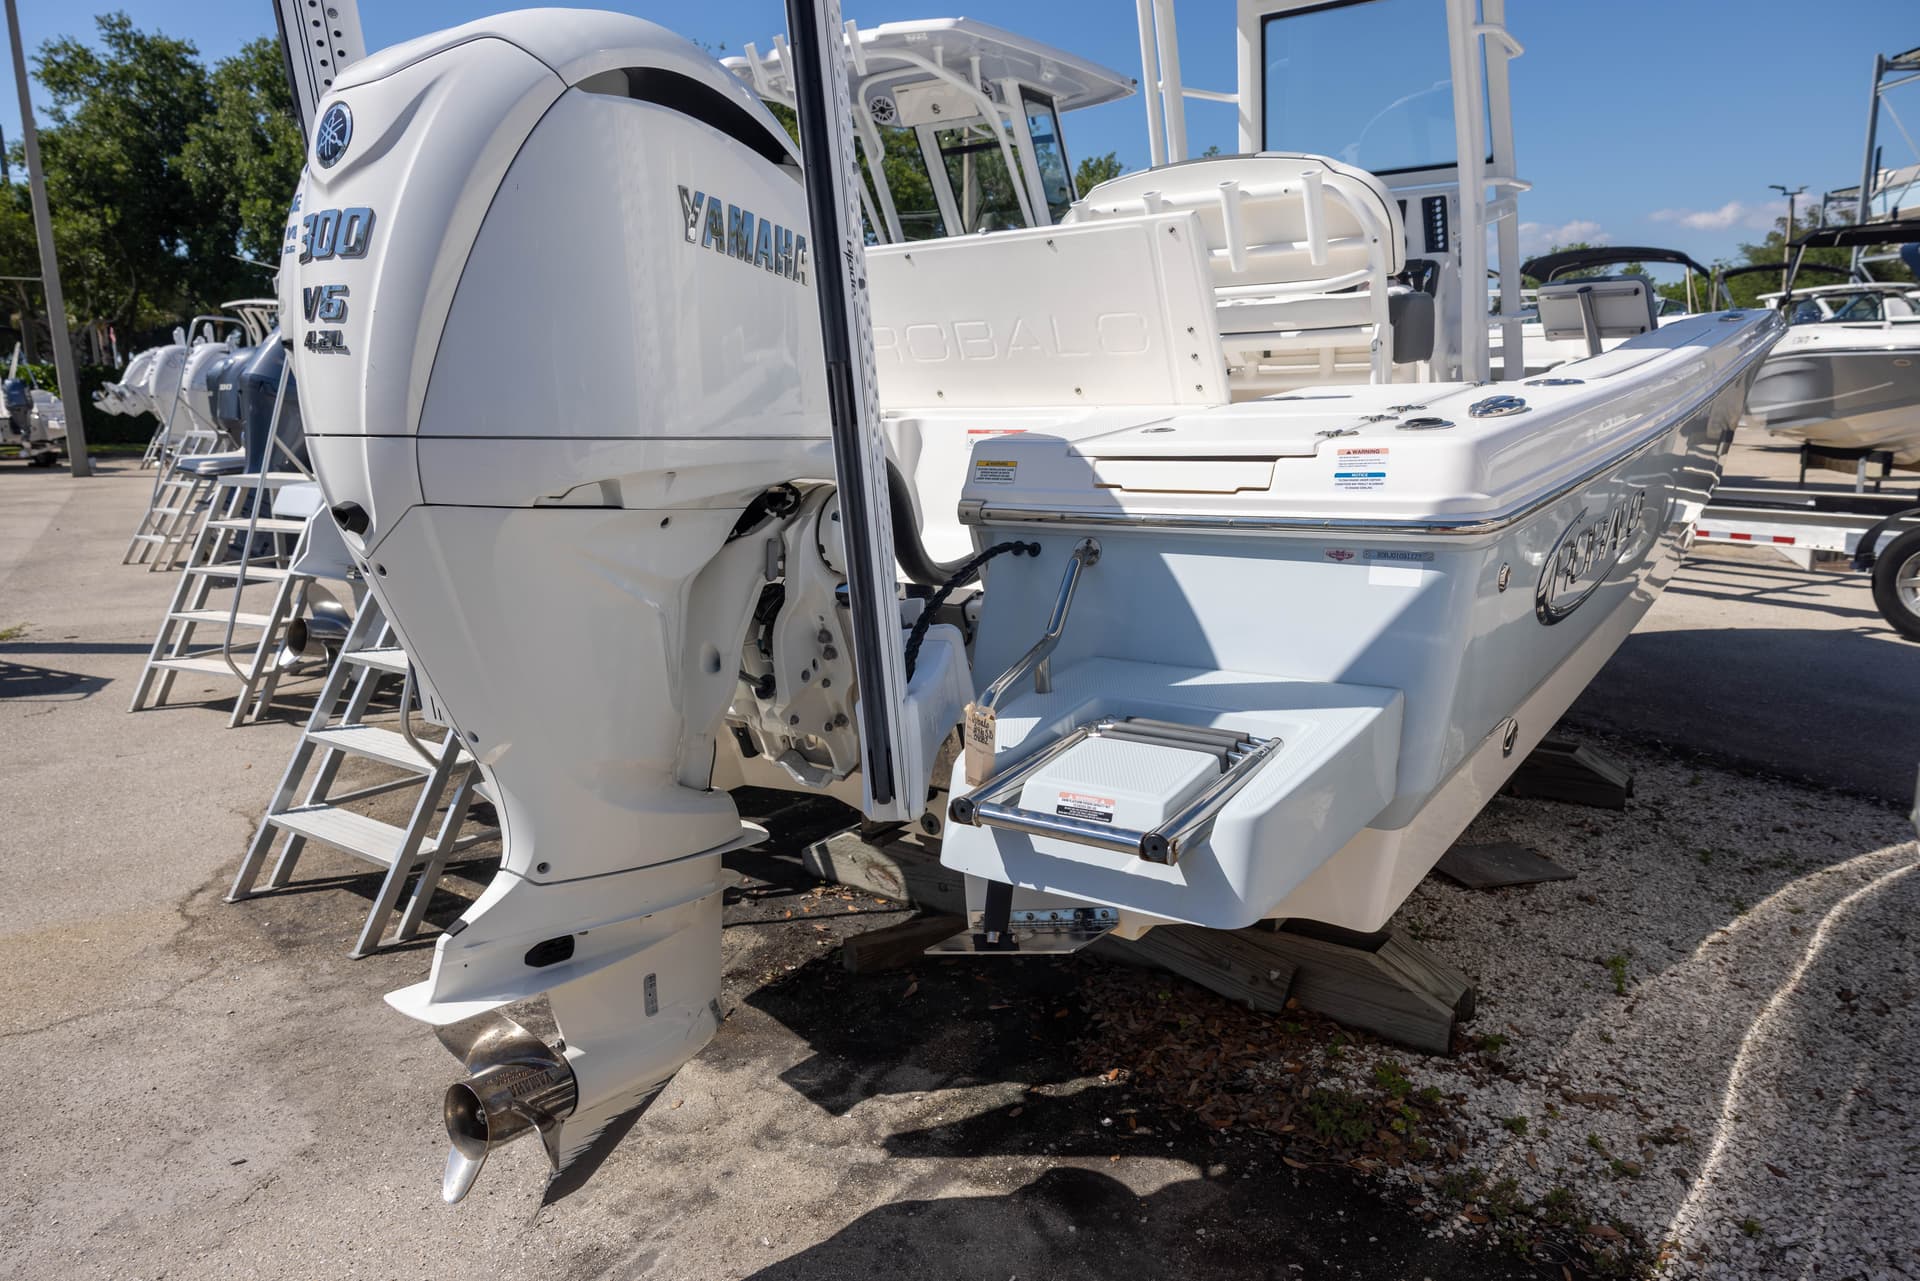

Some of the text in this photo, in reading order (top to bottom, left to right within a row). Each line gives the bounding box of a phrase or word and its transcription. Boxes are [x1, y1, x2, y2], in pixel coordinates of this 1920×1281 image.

[299, 207, 376, 265] 300
[677, 184, 809, 287] YAMAHA
[303, 284, 349, 324] V6
